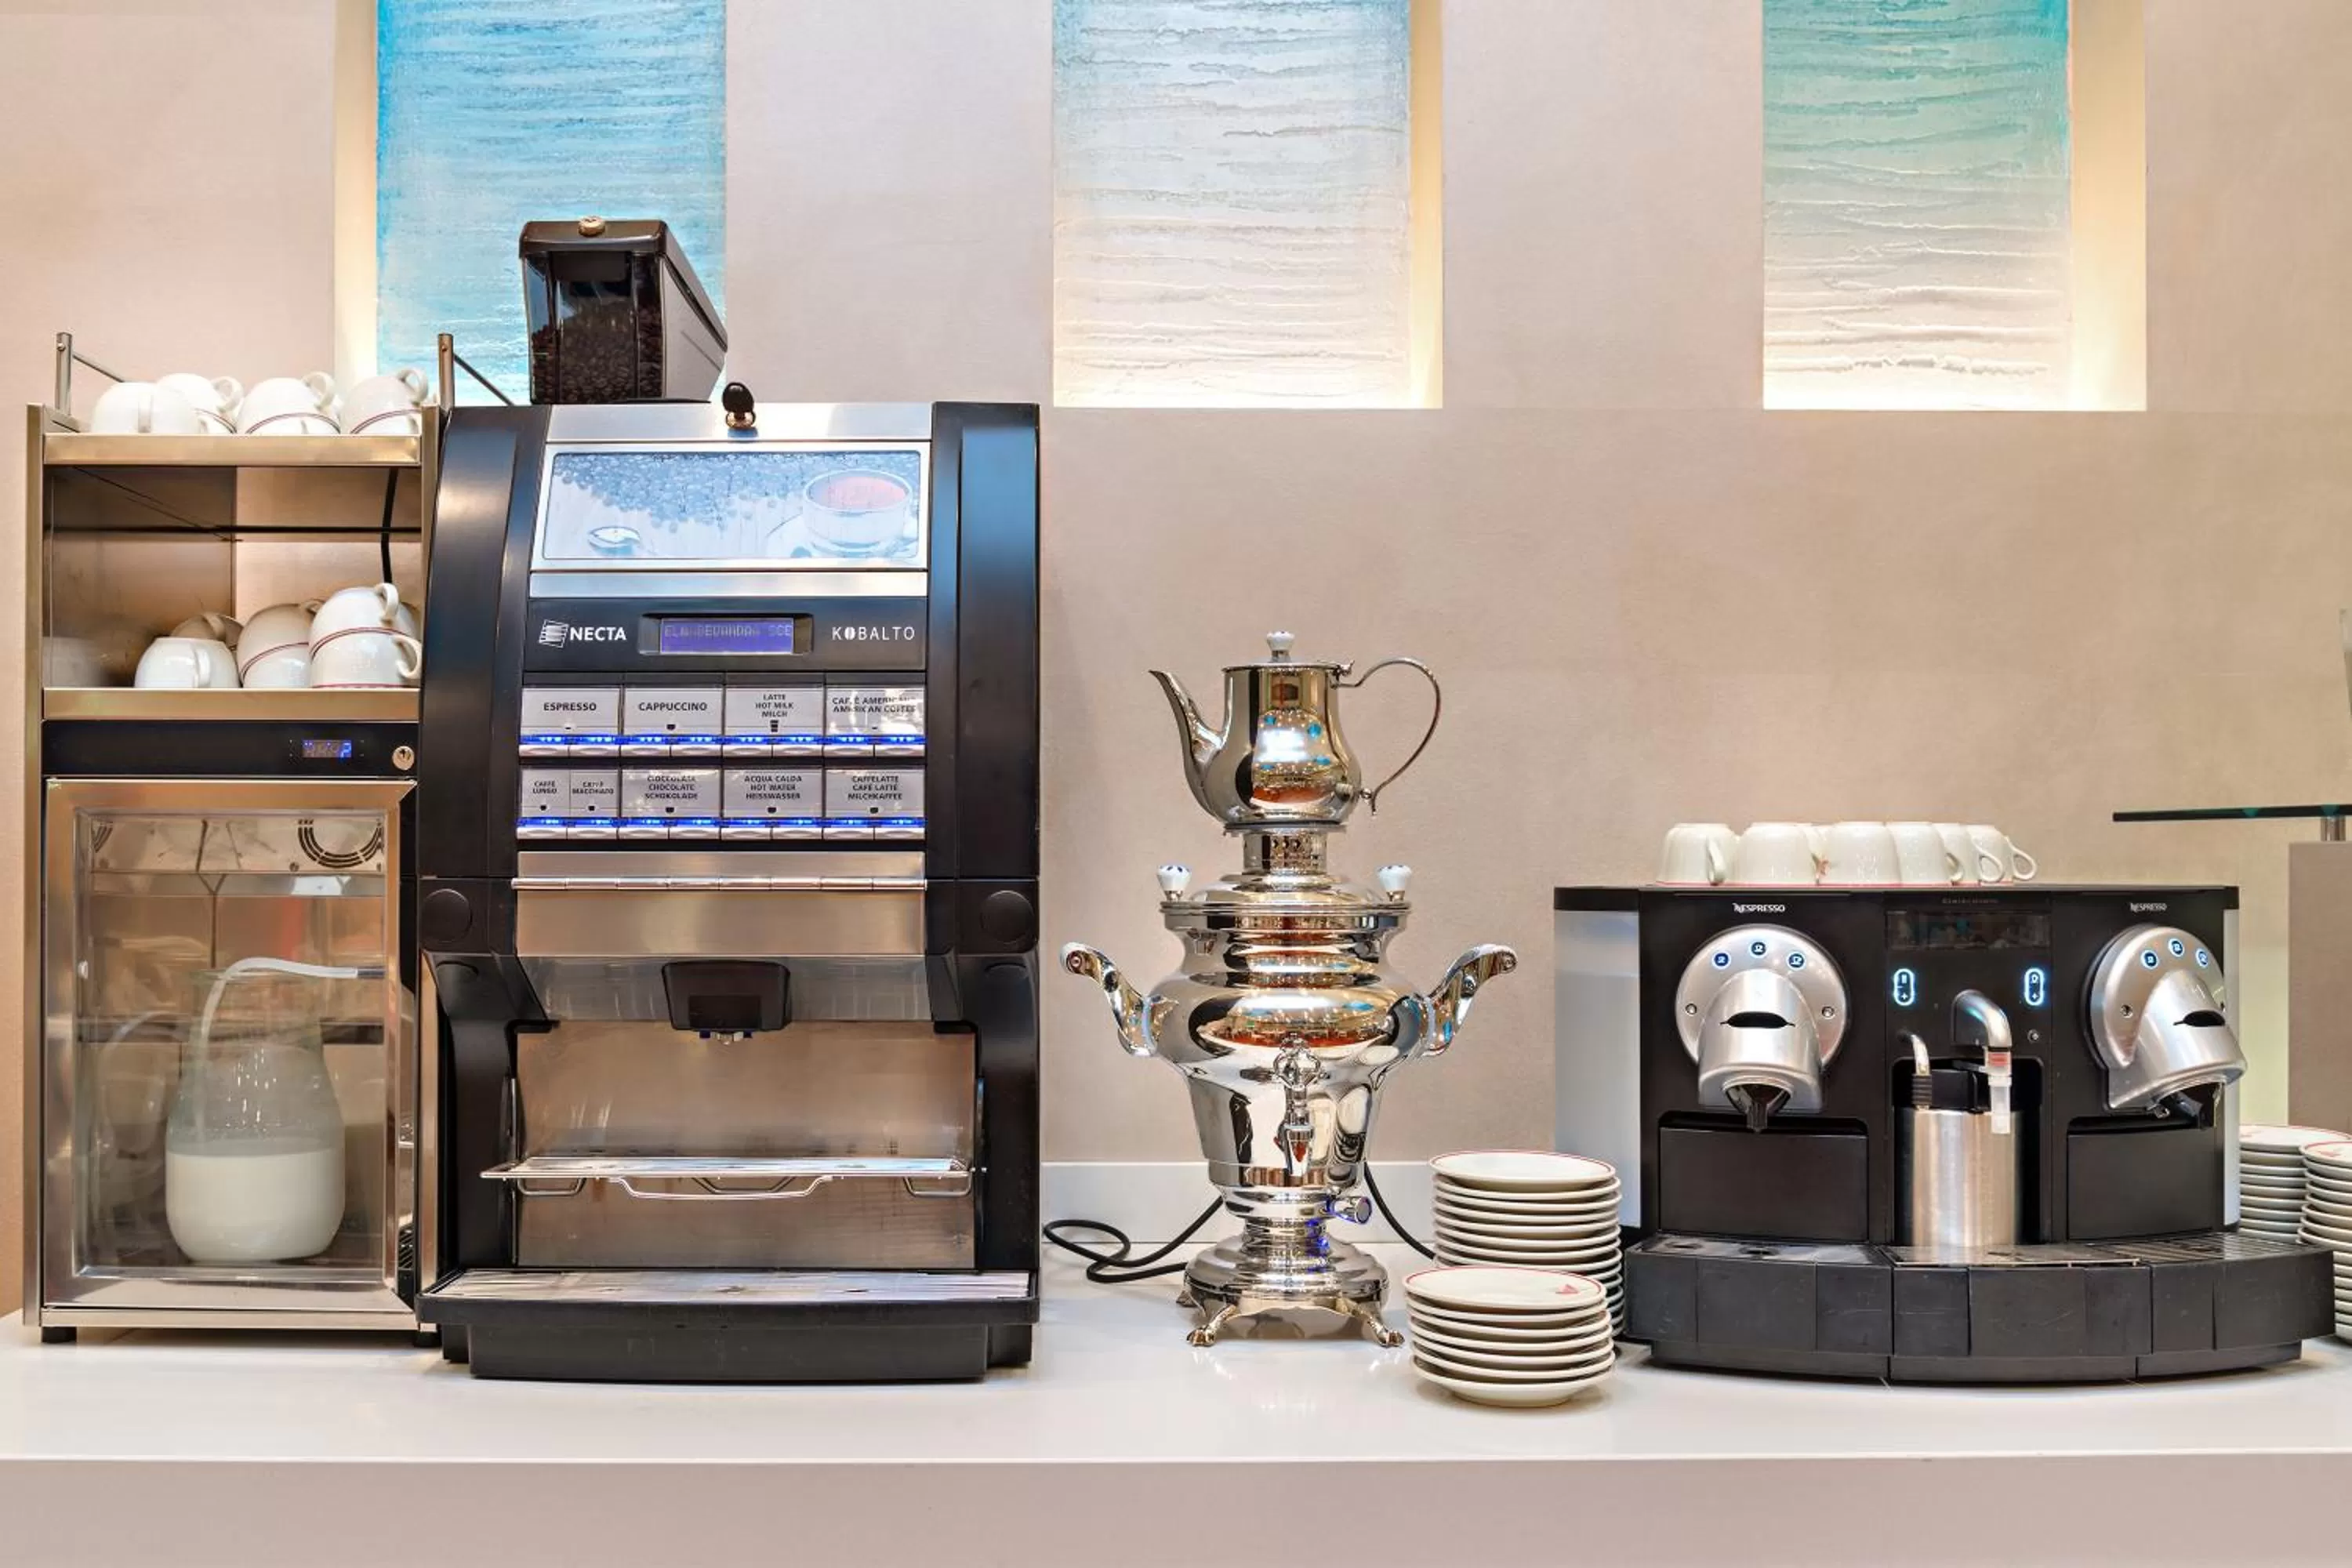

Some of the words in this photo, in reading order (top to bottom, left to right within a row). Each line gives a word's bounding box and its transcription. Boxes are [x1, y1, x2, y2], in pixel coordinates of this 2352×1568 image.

[570, 626, 626, 641] NECTA
[832, 626, 915, 641] KOBALTO
[543, 702, 597, 711] ESPRESSO
[638, 702, 707, 711] CAPPUCCINO
[1732, 902, 1786, 913] NESPRESSO
